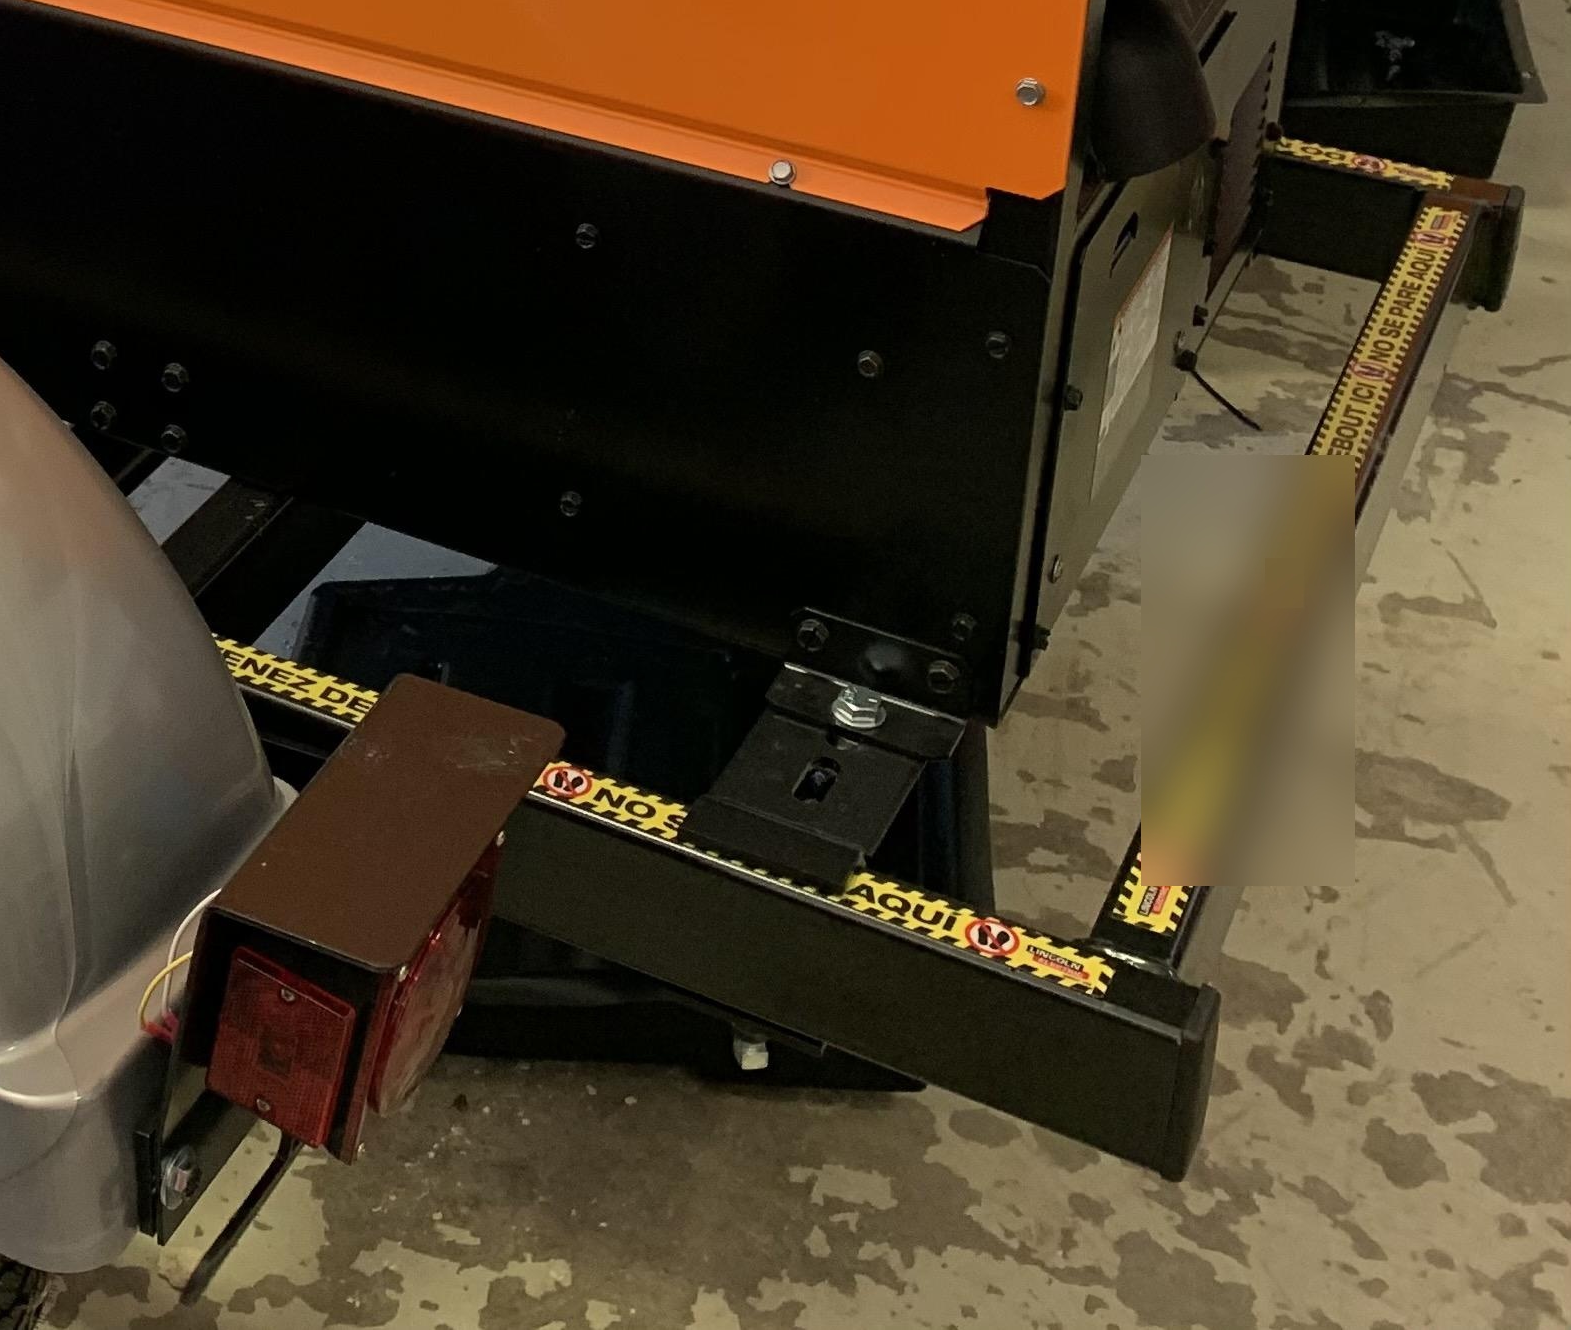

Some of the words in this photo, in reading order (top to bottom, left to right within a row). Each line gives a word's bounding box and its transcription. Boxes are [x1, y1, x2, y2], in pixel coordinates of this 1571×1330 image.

[1389, 279, 1422, 320] PARE
[1368, 332, 1395, 363] NO
[1379, 317, 1402, 339] SE
[1327, 404, 1366, 455] EBOUT
[1356, 381, 1377, 406] ICI
[223, 650, 317, 694] ENEZ
[593, 787, 657, 819] NO
[663, 814, 684, 831] S
[1029, 946, 1083, 971] LINCOLN
